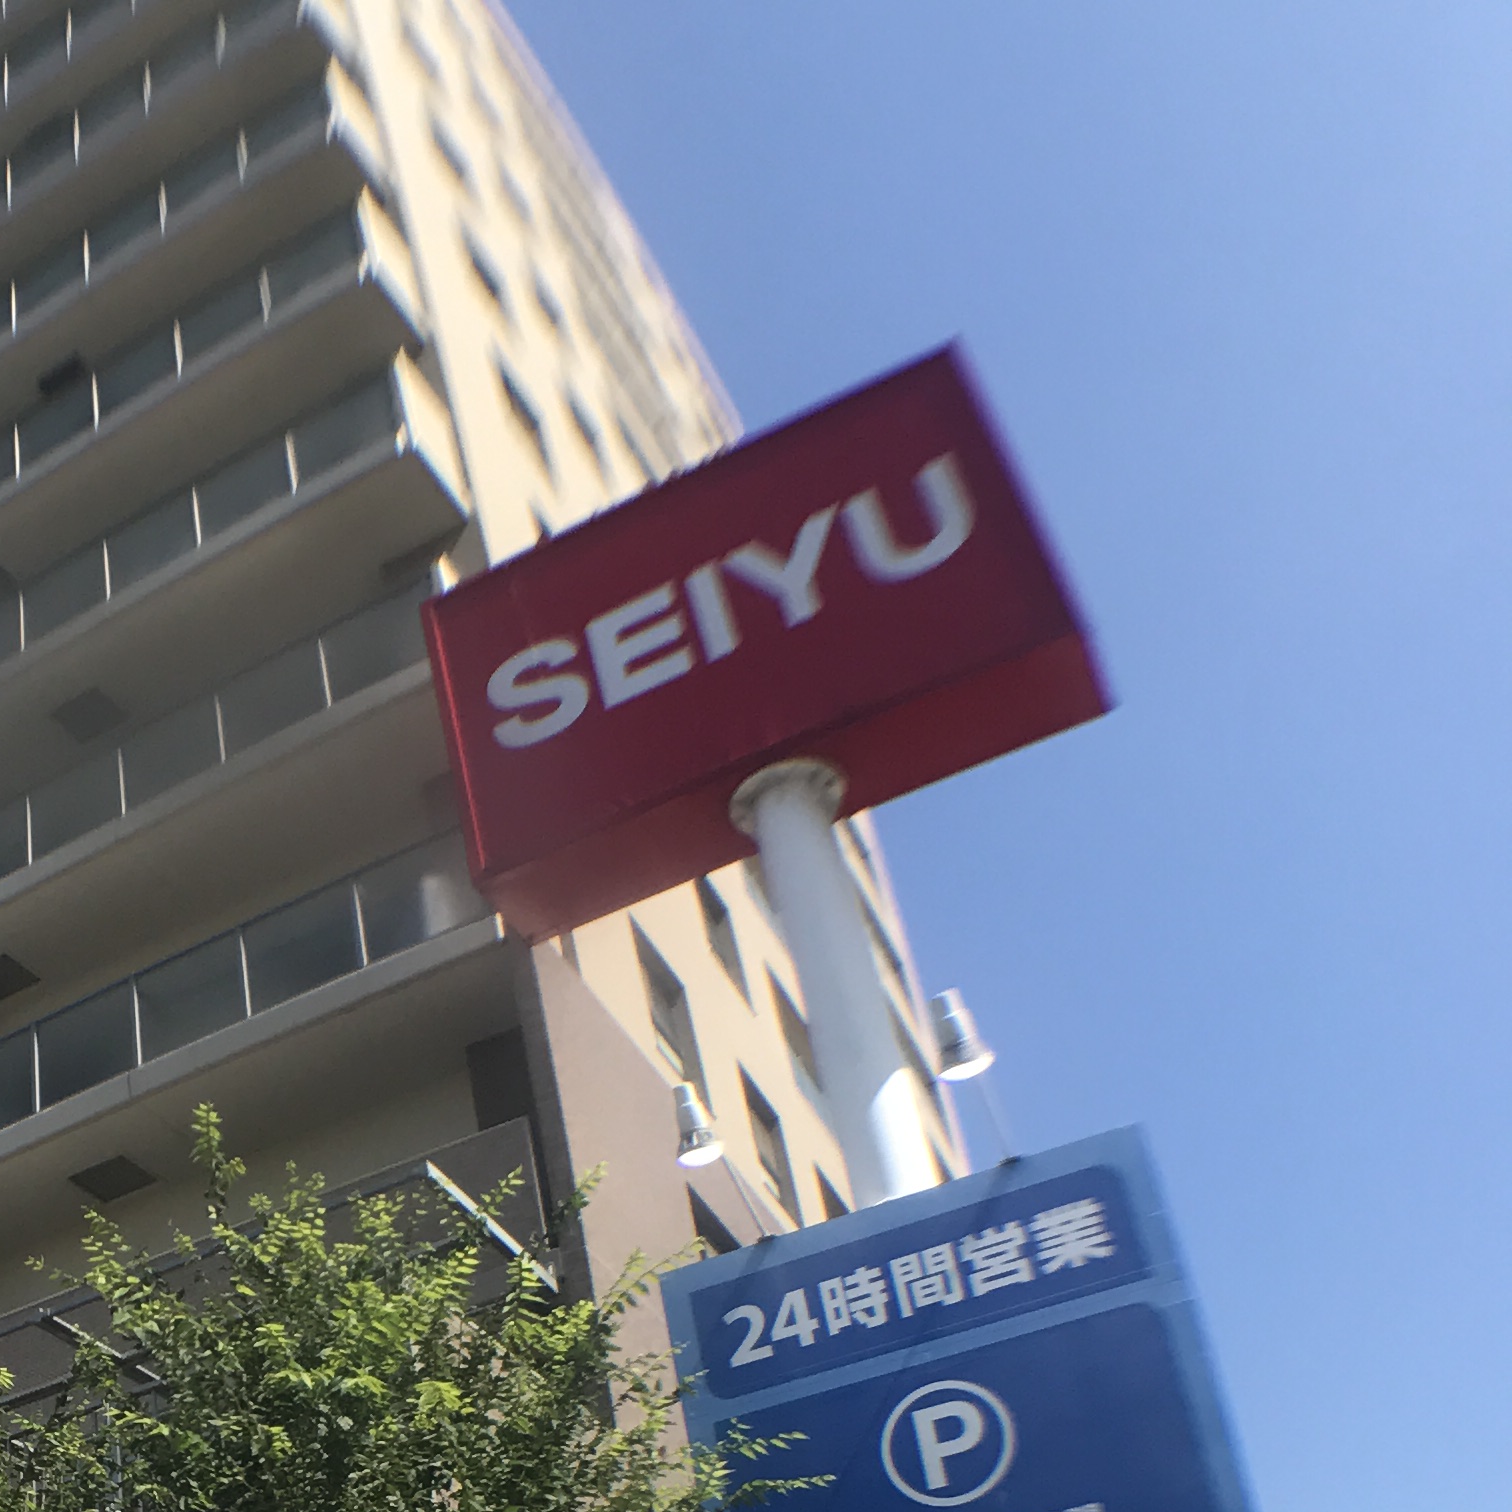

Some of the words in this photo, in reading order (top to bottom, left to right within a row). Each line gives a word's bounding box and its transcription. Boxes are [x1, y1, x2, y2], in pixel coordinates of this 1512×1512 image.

[487, 452, 976, 748] SEIYU
[723, 1198, 1116, 1368] 24時間営業
[911, 1400, 986, 1490] P
